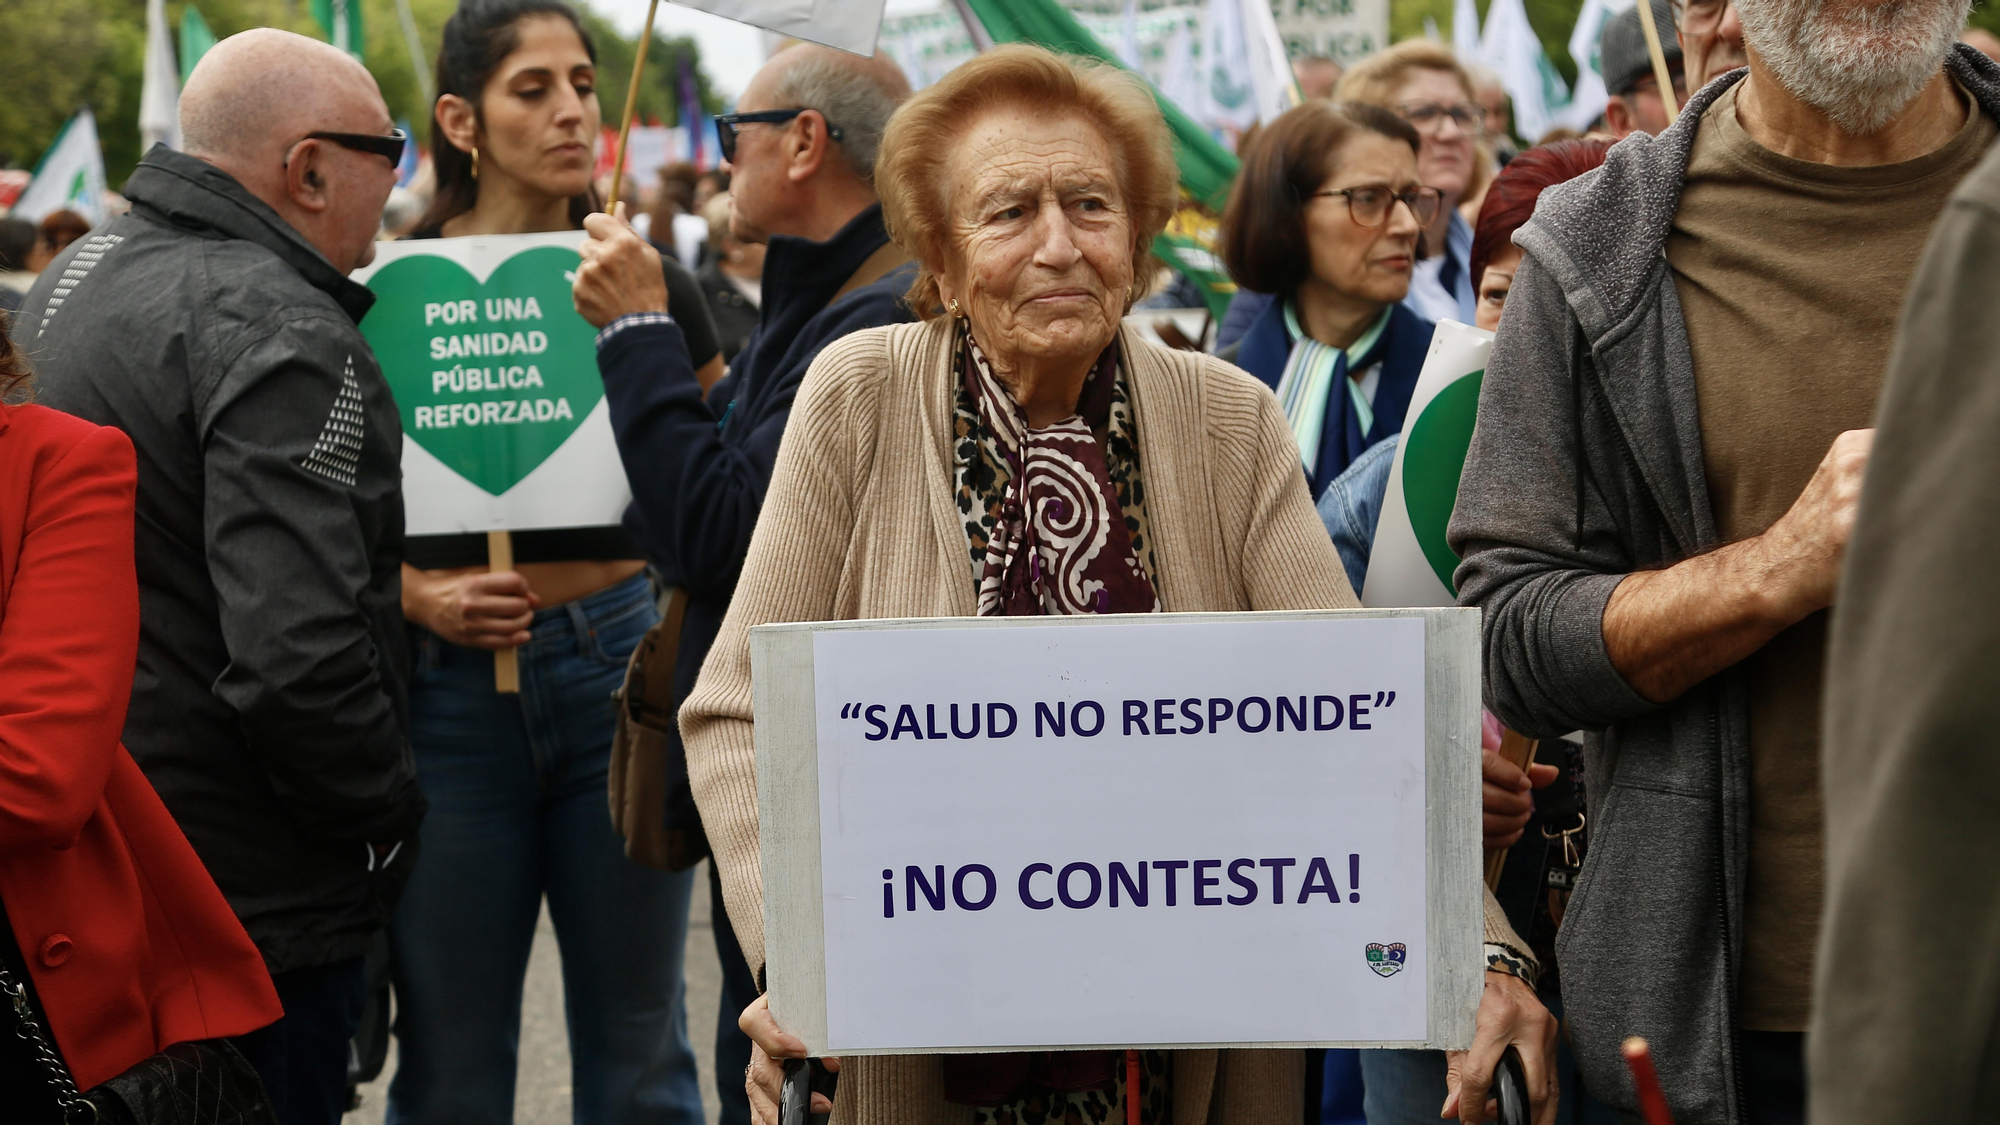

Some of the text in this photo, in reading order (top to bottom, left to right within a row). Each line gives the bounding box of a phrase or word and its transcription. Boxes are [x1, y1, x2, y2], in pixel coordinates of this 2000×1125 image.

[425, 297, 543, 326] POR UNA
[430, 331, 548, 360] SANIDAD
[432, 364, 544, 394] PÚBLICA
[415, 398, 573, 429] REFORZADA
[840, 691, 1396, 741] “SALUD NO RESPONDE”
[882, 854, 1360, 918] ¡NO CONTESTA!
